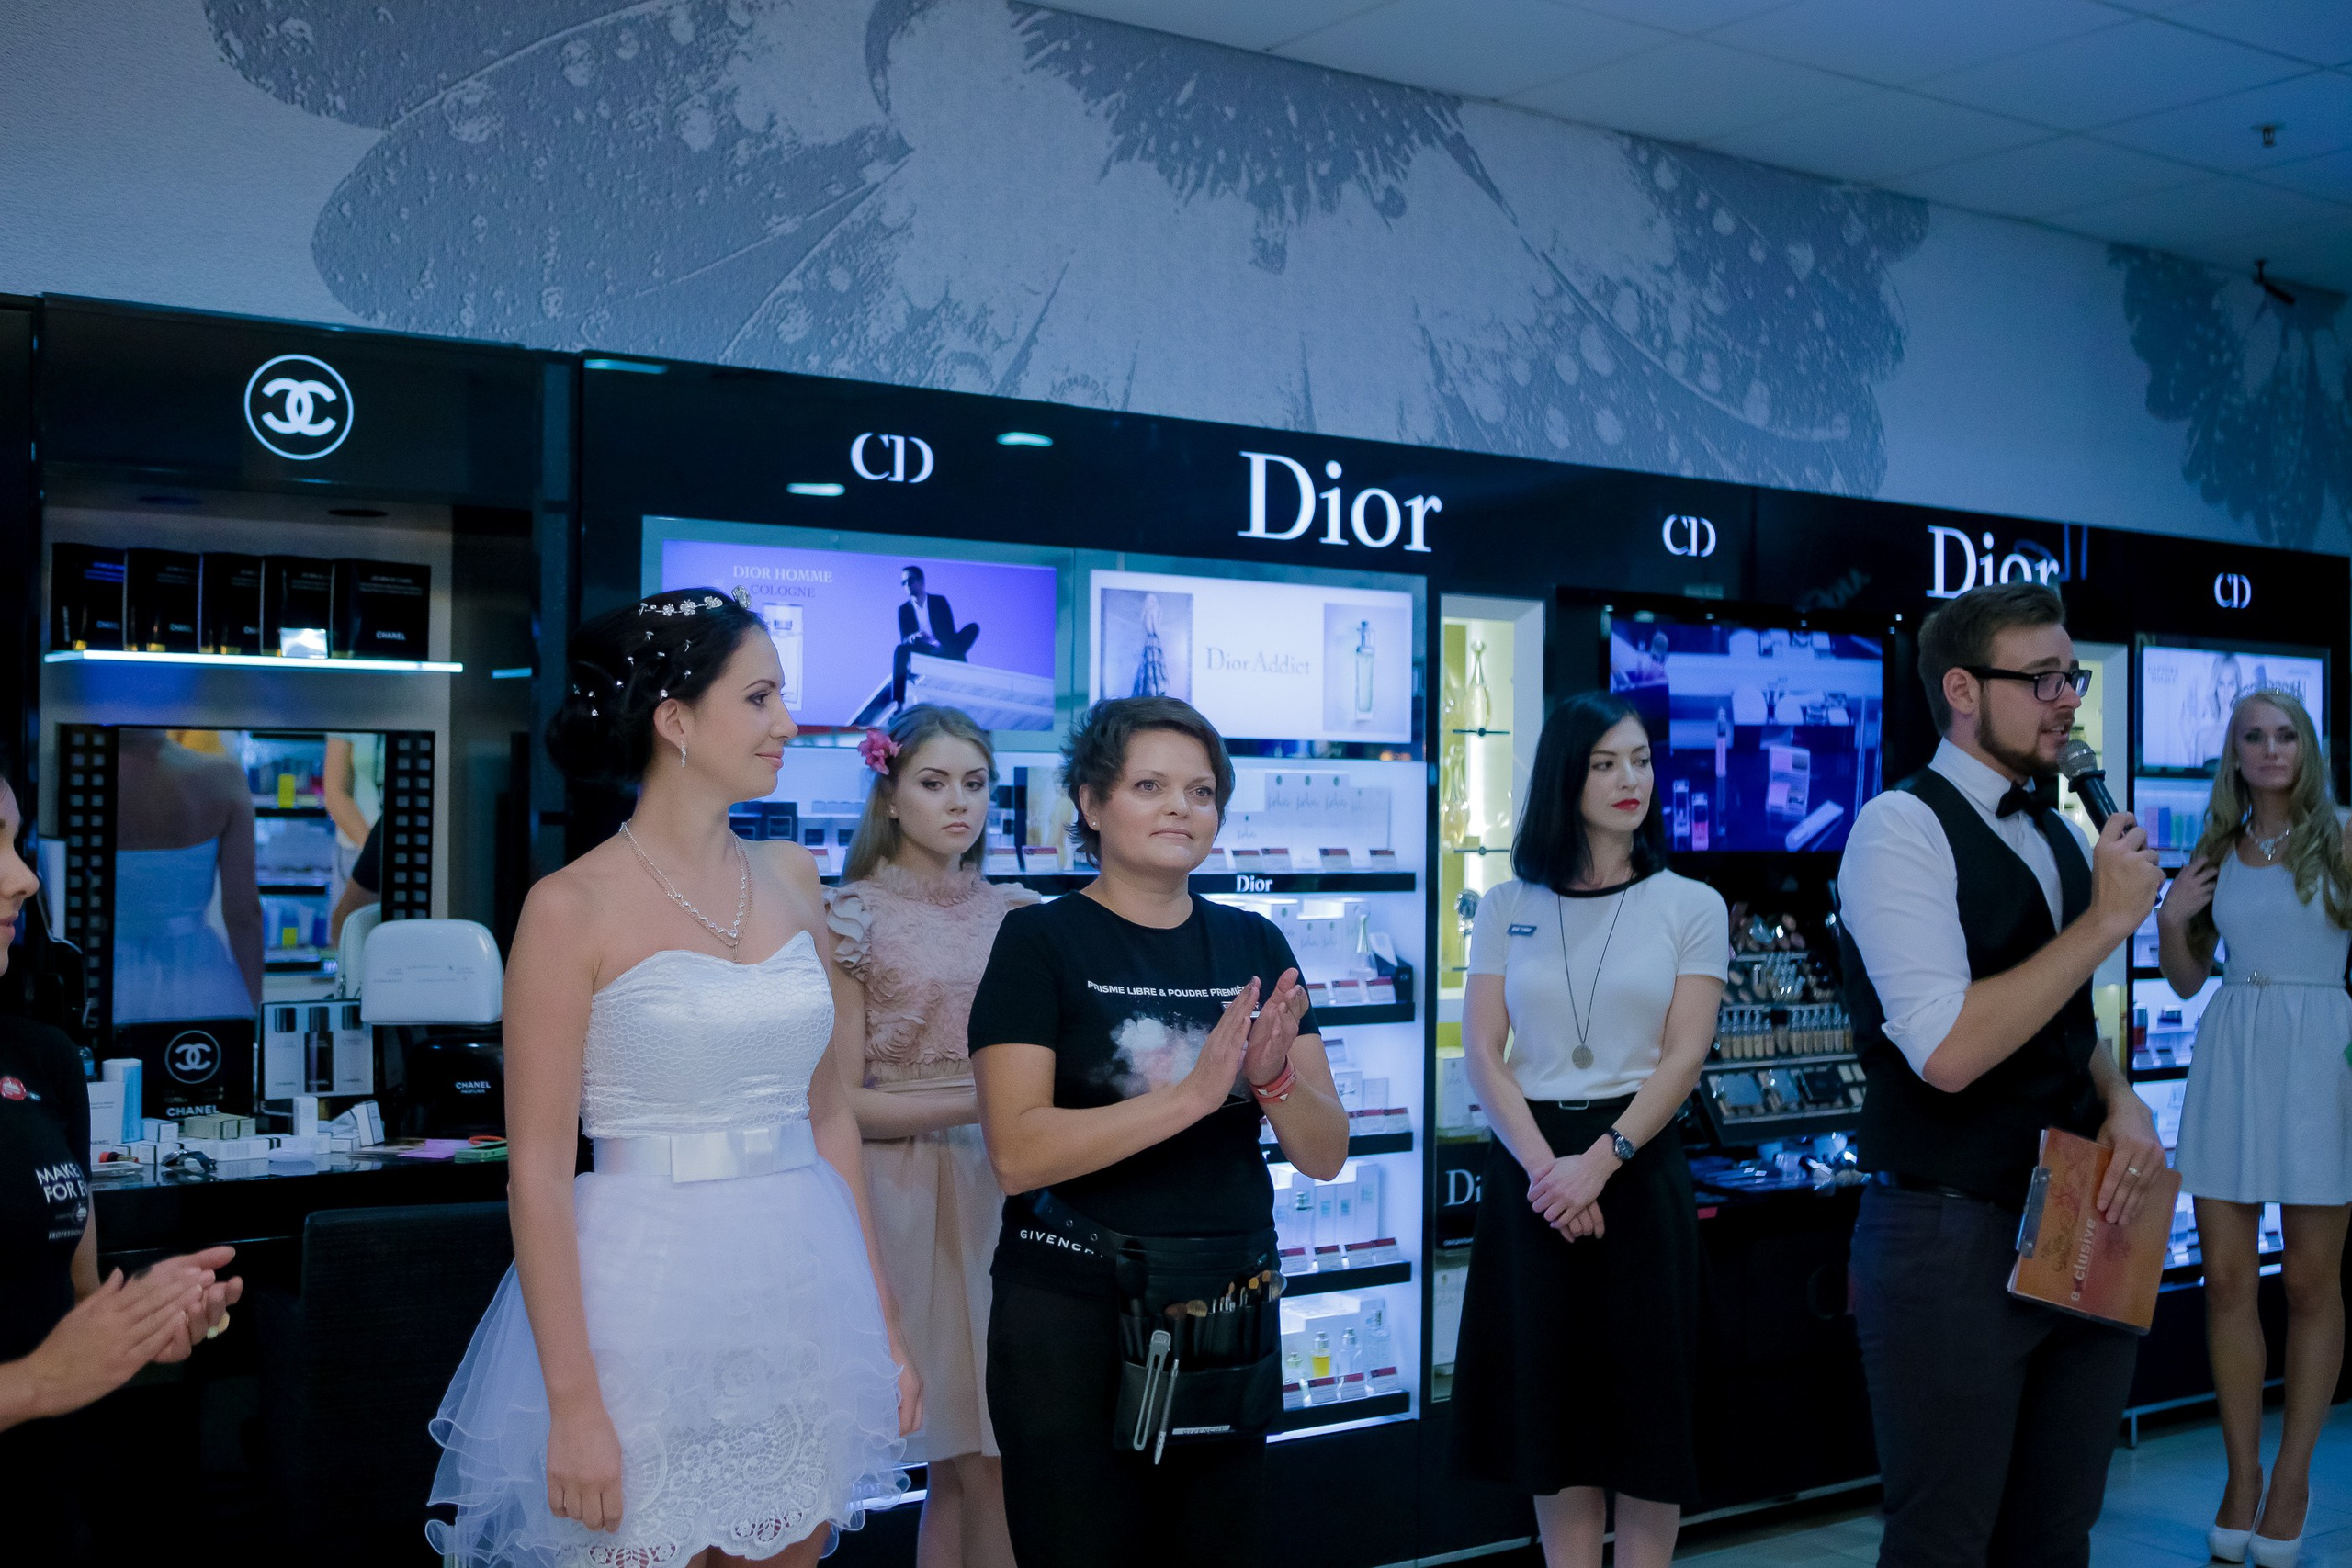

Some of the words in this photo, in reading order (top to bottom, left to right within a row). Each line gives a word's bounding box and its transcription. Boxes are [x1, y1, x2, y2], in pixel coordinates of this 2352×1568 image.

[1237, 451, 1442, 553] Dior
[1927, 525, 2060, 599] Dior
[733, 565, 771, 580] DIOR
[775, 568, 833, 583] HOMME
[751, 584, 815, 598] COLOGNE
[376, 630, 406, 640] CHANEL
[1205, 646, 1250, 671] Dior
[1252, 650, 1310, 674] Addict
[1236, 874, 1273, 893] Dior
[1087, 980, 1125, 994] PRISME
[1126, 986, 1157, 996] LIBRE
[1168, 988, 1209, 998] POUDRE
[1210, 985, 1247, 998] PREMIÈ
[455, 1081, 492, 1089] CHANEL
[166, 1104, 220, 1117] CHANEL
[35, 1161, 80, 1186] MAKE
[43, 1181, 78, 1203] FOR
[1443, 1168, 1482, 1207] Di
[1020, 1229, 1103, 1258] GIVENC
[2070, 1216, 2098, 1303] exclusive
